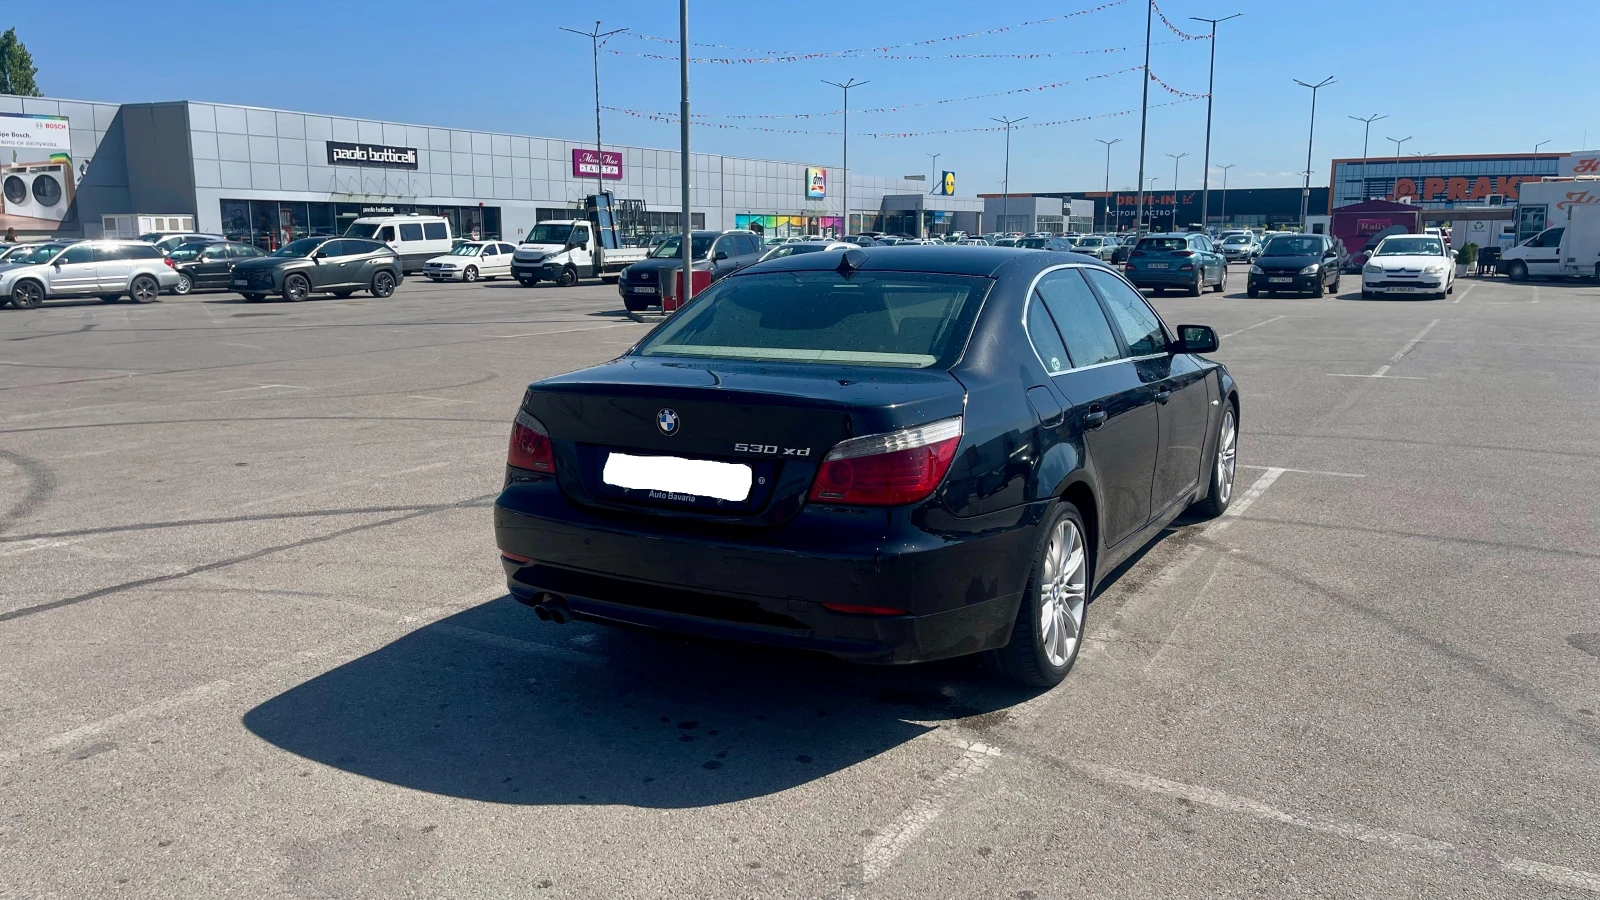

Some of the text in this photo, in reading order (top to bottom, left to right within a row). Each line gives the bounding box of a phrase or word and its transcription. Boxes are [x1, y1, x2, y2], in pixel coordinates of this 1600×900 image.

[333, 146, 416, 164] paolo botticelli
[812, 172, 824, 186] dm
[734, 443, 811, 457] 530 xd
[649, 490, 696, 503] Auto Bavaria
